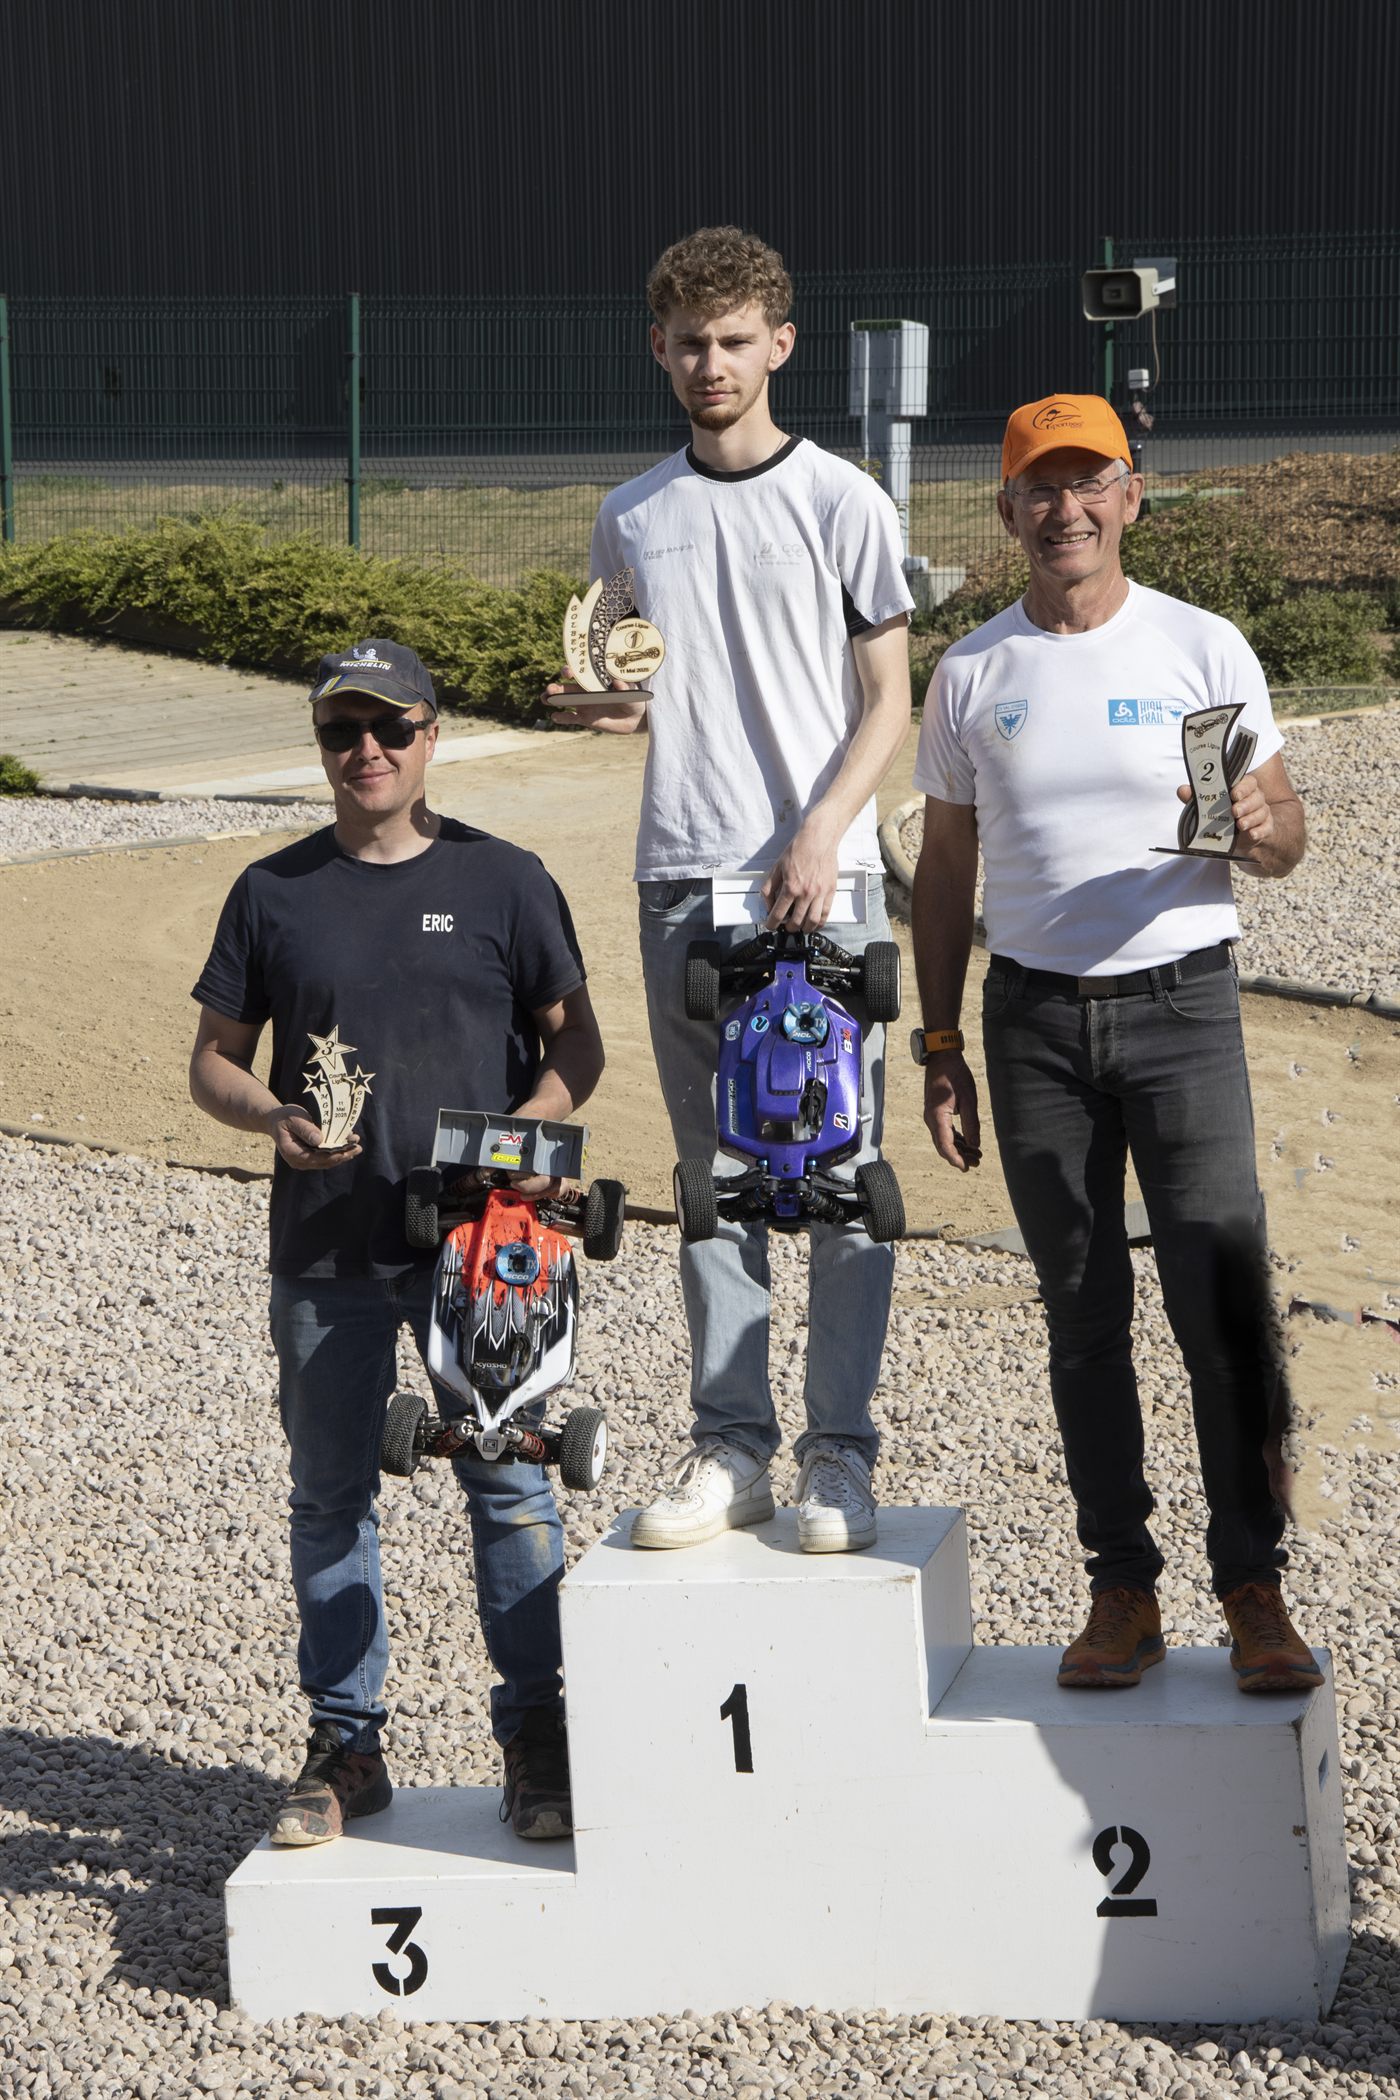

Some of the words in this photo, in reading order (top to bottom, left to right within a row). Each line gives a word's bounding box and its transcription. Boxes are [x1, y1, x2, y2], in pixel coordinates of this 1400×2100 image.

[631, 631, 638, 648] 1
[340, 662, 392, 670] MICHELIN
[1201, 763, 1215, 782] 2
[422, 914, 454, 932] ERIC
[321, 1041, 334, 1055] 3
[720, 1684, 754, 1773] 1
[1092, 1825, 1158, 1918] 2
[371, 1907, 428, 1996] 3
